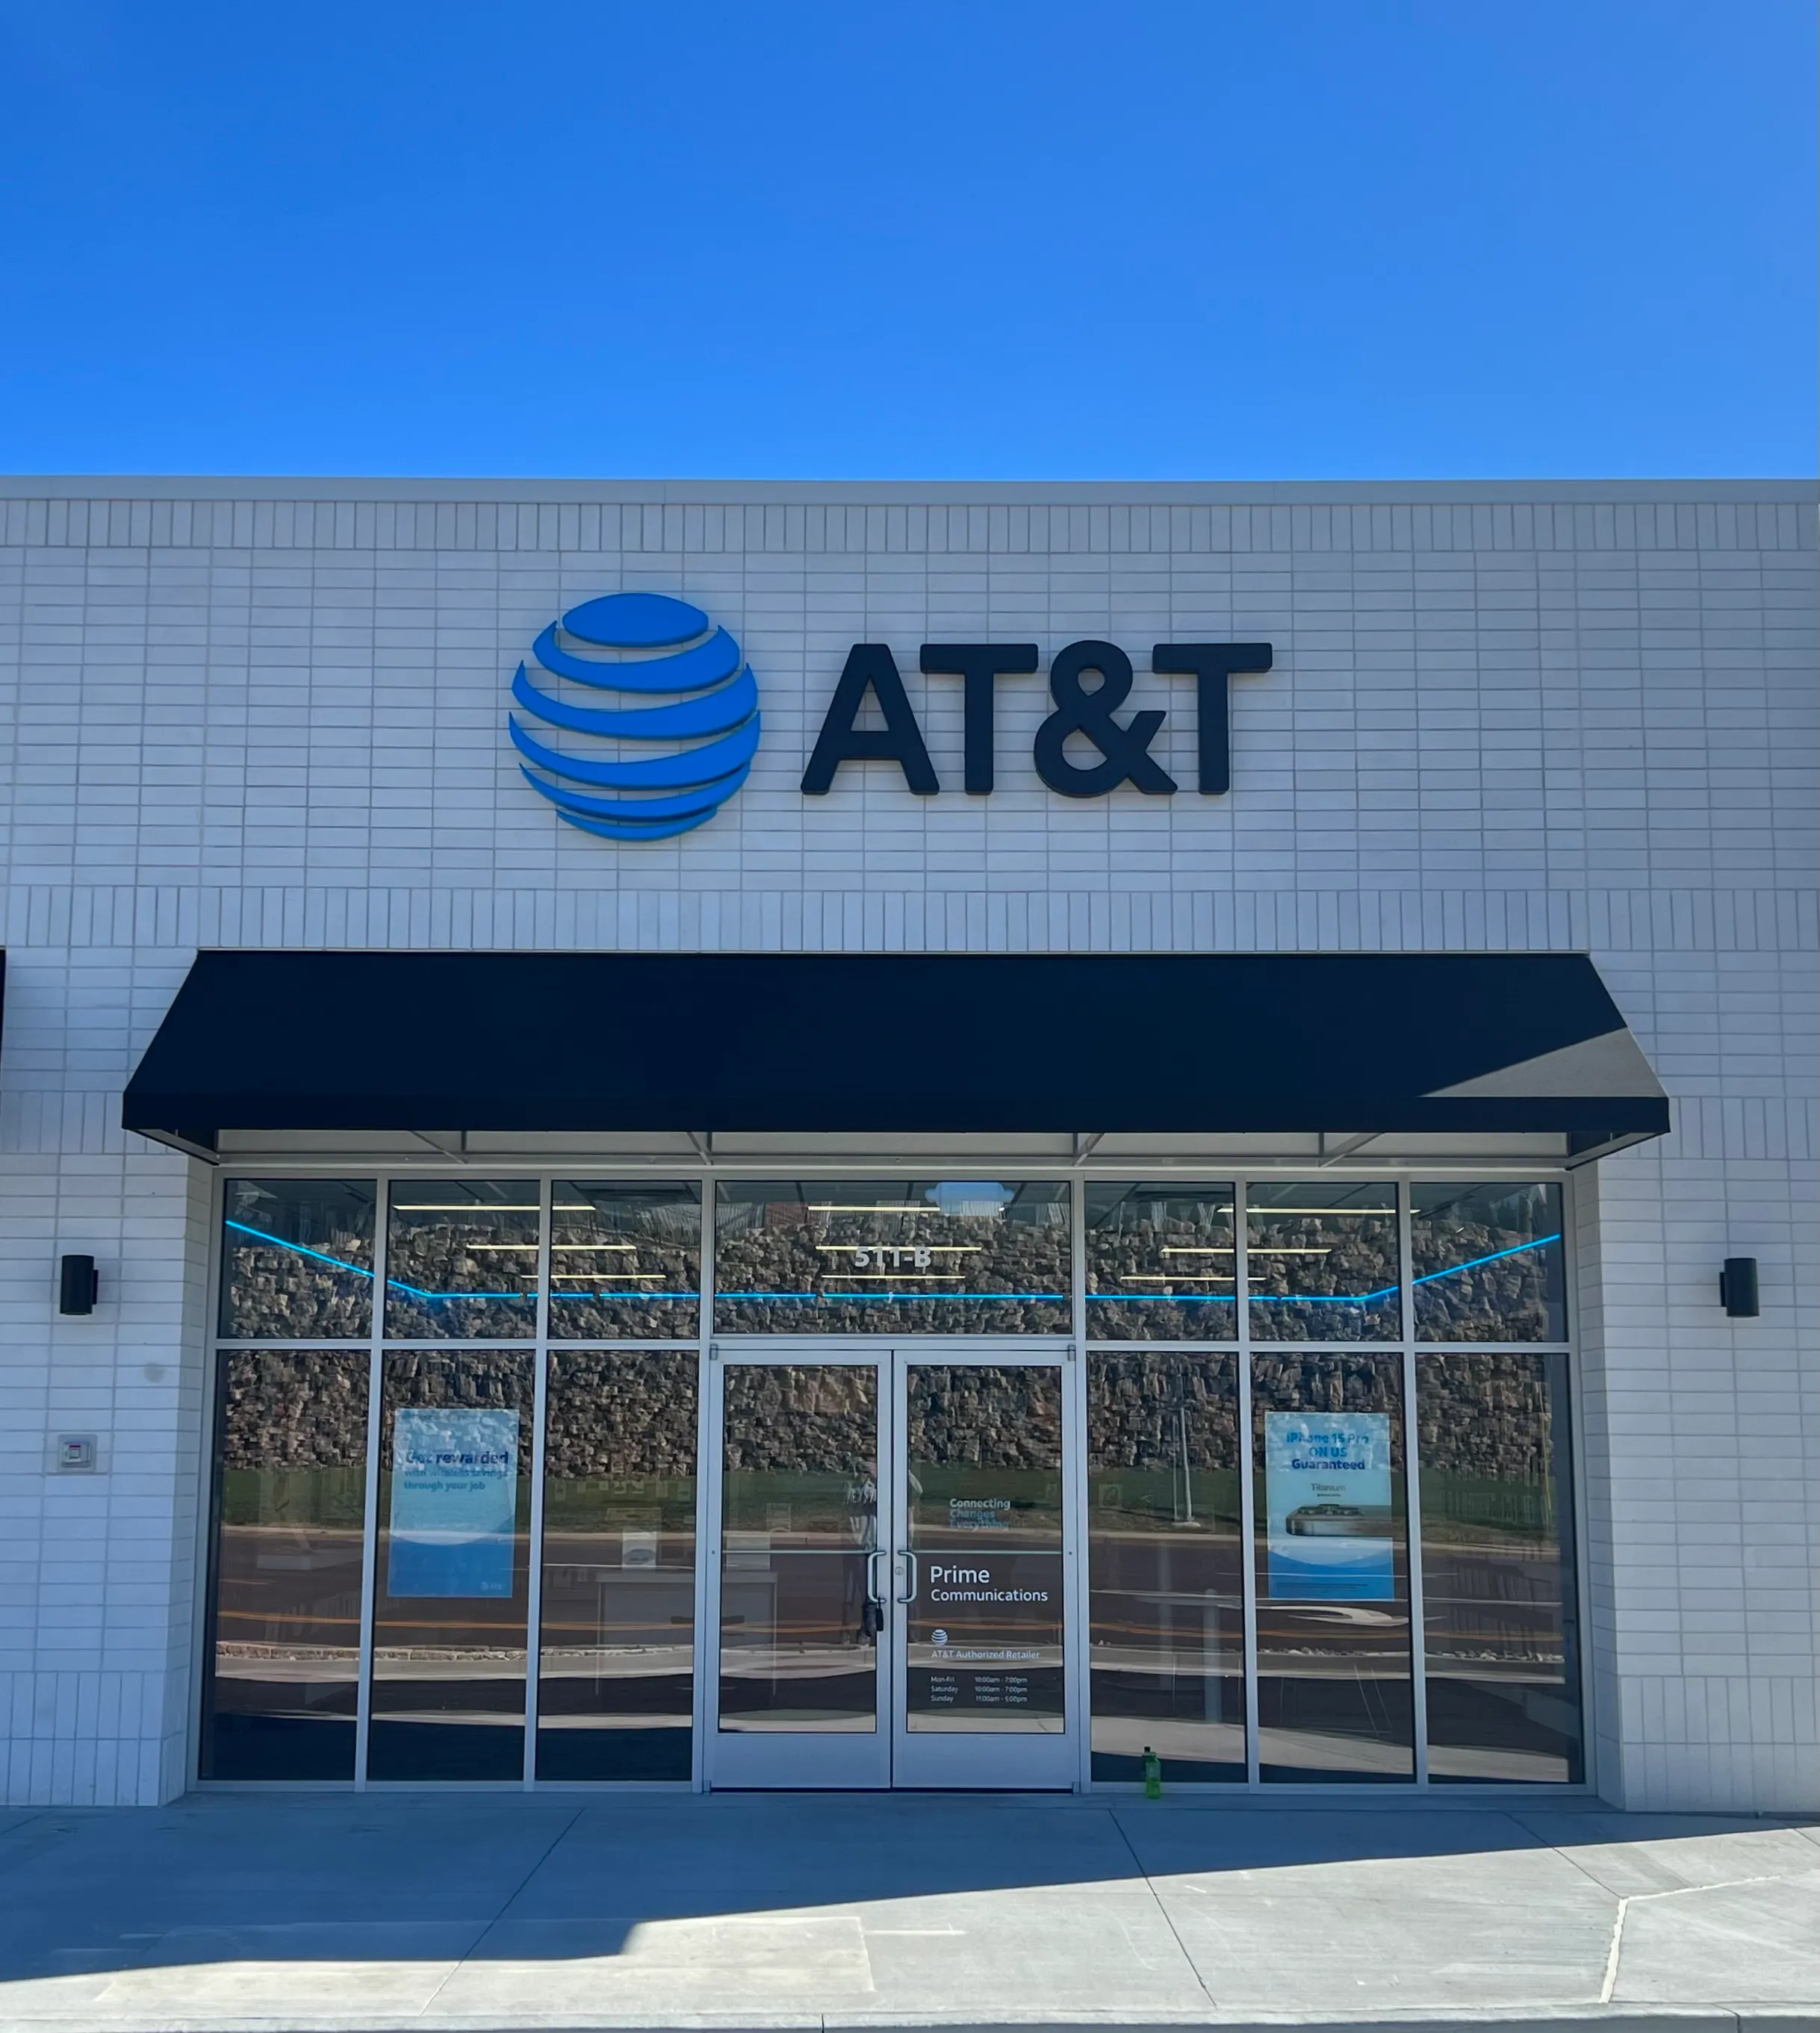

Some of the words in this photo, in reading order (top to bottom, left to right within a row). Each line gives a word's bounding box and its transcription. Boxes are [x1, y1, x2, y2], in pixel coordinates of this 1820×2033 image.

[800, 639, 1273, 798] AT&T
[854, 1246, 931, 1267] 511-B
[1286, 1432, 1329, 1443] iPhone
[1332, 1433, 1345, 1443] 15
[1347, 1433, 1369, 1444] Pro
[436, 1450, 509, 1465] rewarded
[1308, 1447, 1328, 1457] ON
[1331, 1447, 1348, 1457] US
[1291, 1459, 1365, 1470] Guaranteed
[404, 1480, 443, 1492] through
[446, 1482, 468, 1492] your
[470, 1480, 485, 1492] job
[1311, 1483, 1347, 1492] Titanium
[949, 1498, 1011, 1510] Connecting
[949, 1509, 996, 1520] Changes
[949, 1519, 1010, 1532] Everything
[931, 1565, 990, 1583] Prime
[931, 1588, 1049, 1601] Communications
[931, 1649, 954, 1659] AT&T
[956, 1649, 1004, 1660] Authorized
[1006, 1649, 1040, 1660] Retailer
[931, 1685, 959, 1694] Saturday
[931, 1695, 954, 1703] Sunday
